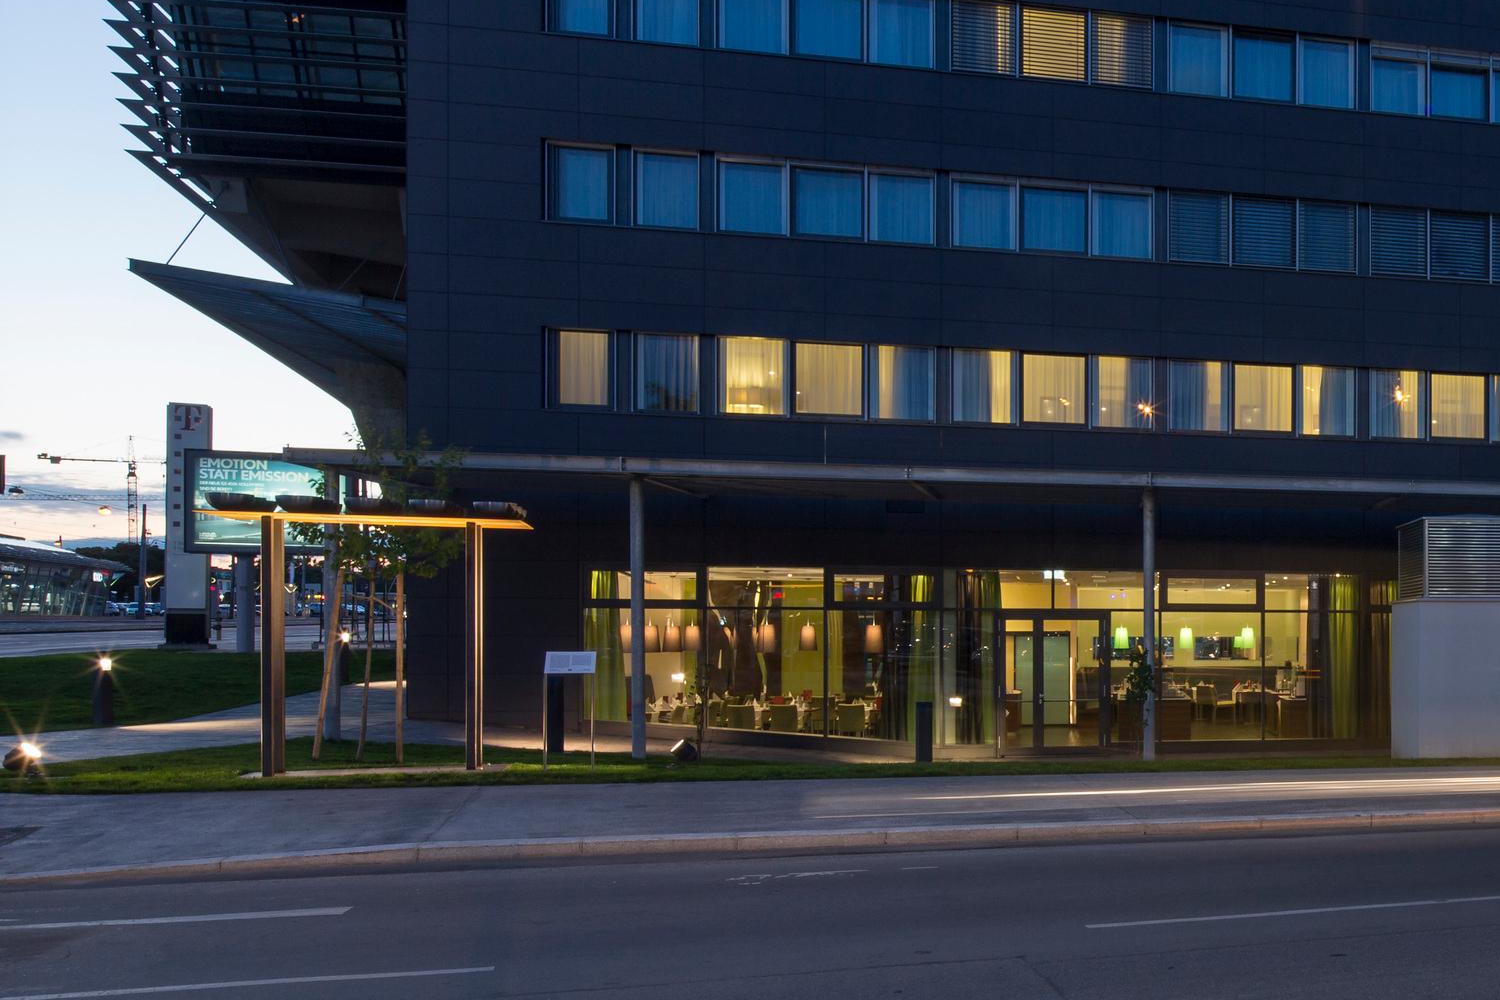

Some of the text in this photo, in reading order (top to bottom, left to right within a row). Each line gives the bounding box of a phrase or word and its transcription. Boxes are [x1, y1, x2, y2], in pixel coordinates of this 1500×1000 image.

[199, 458, 268, 470] EMOTION
[199, 469, 309, 482] STATT EMISSION
